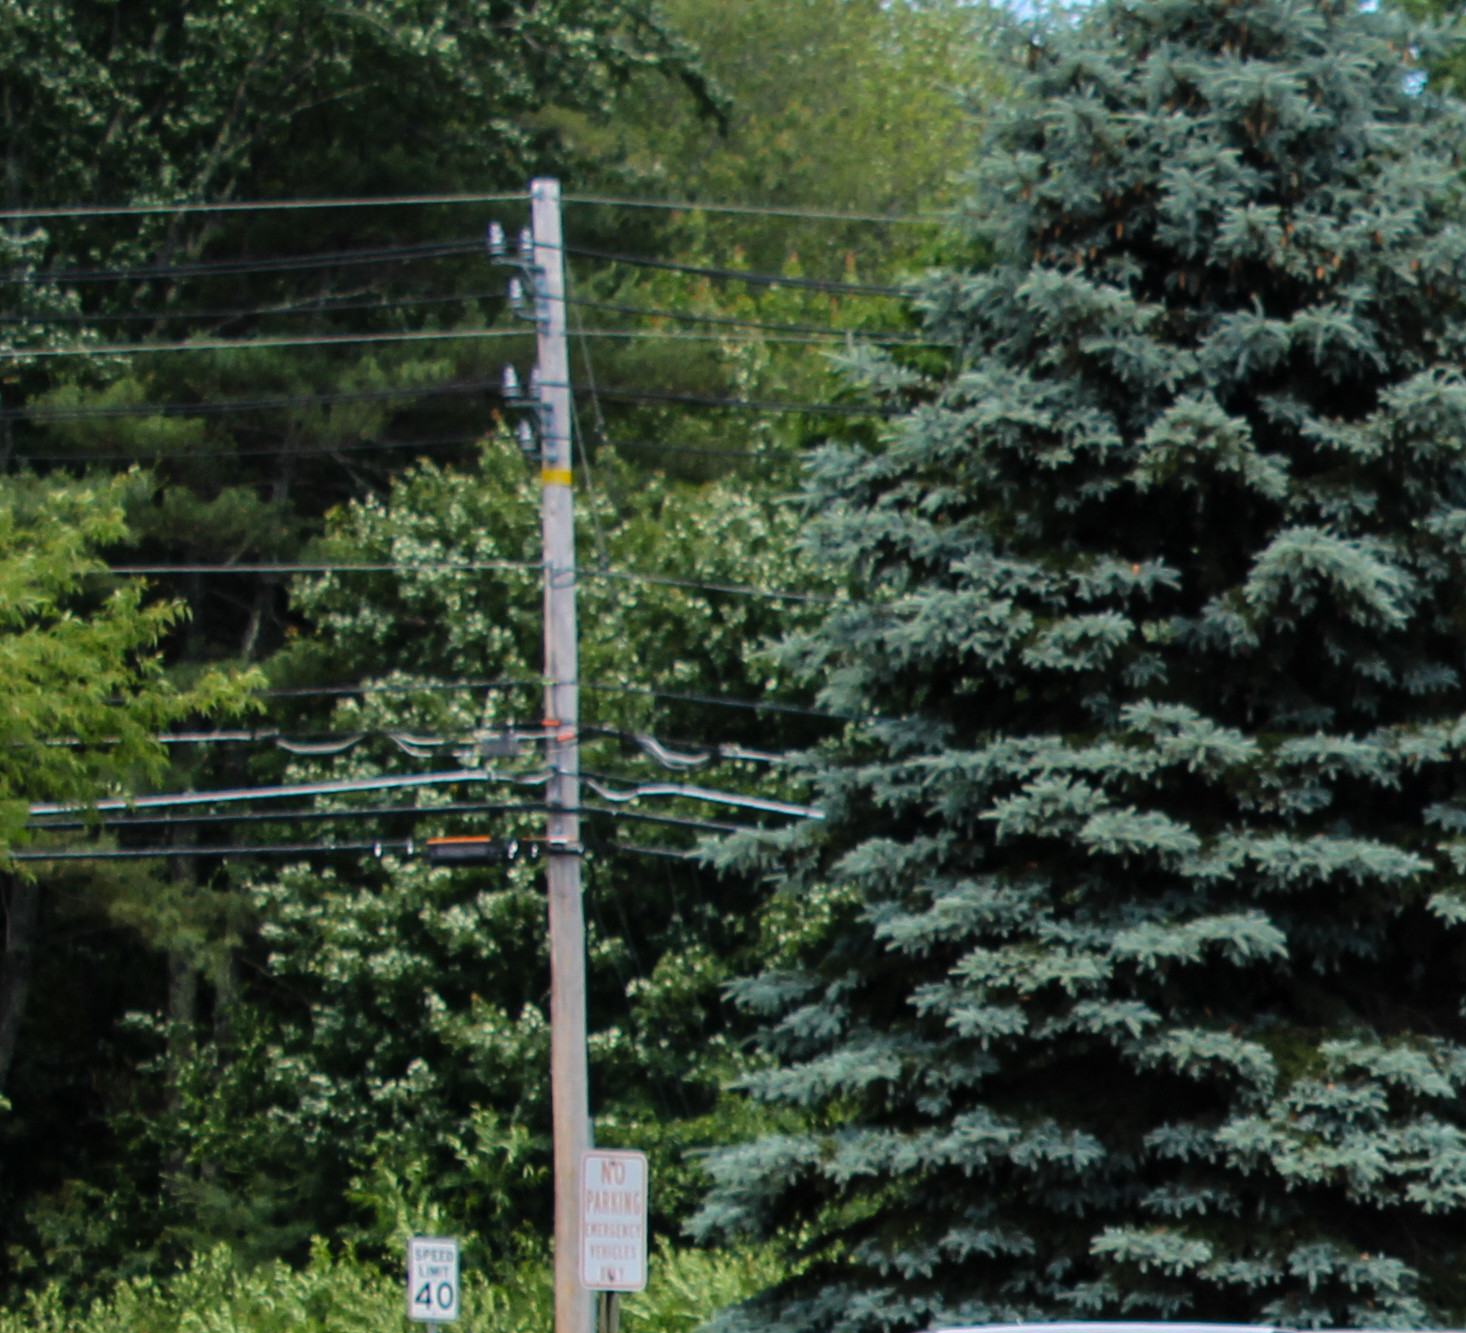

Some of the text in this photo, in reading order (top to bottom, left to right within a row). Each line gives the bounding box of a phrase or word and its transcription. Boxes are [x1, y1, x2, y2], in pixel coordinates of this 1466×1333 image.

[601, 1161, 626, 1185] NO
[587, 1191, 641, 1215] PARKING
[415, 1247, 454, 1262] SPEED
[418, 1265, 449, 1278] LIMIT
[415, 1281, 454, 1310] 40
